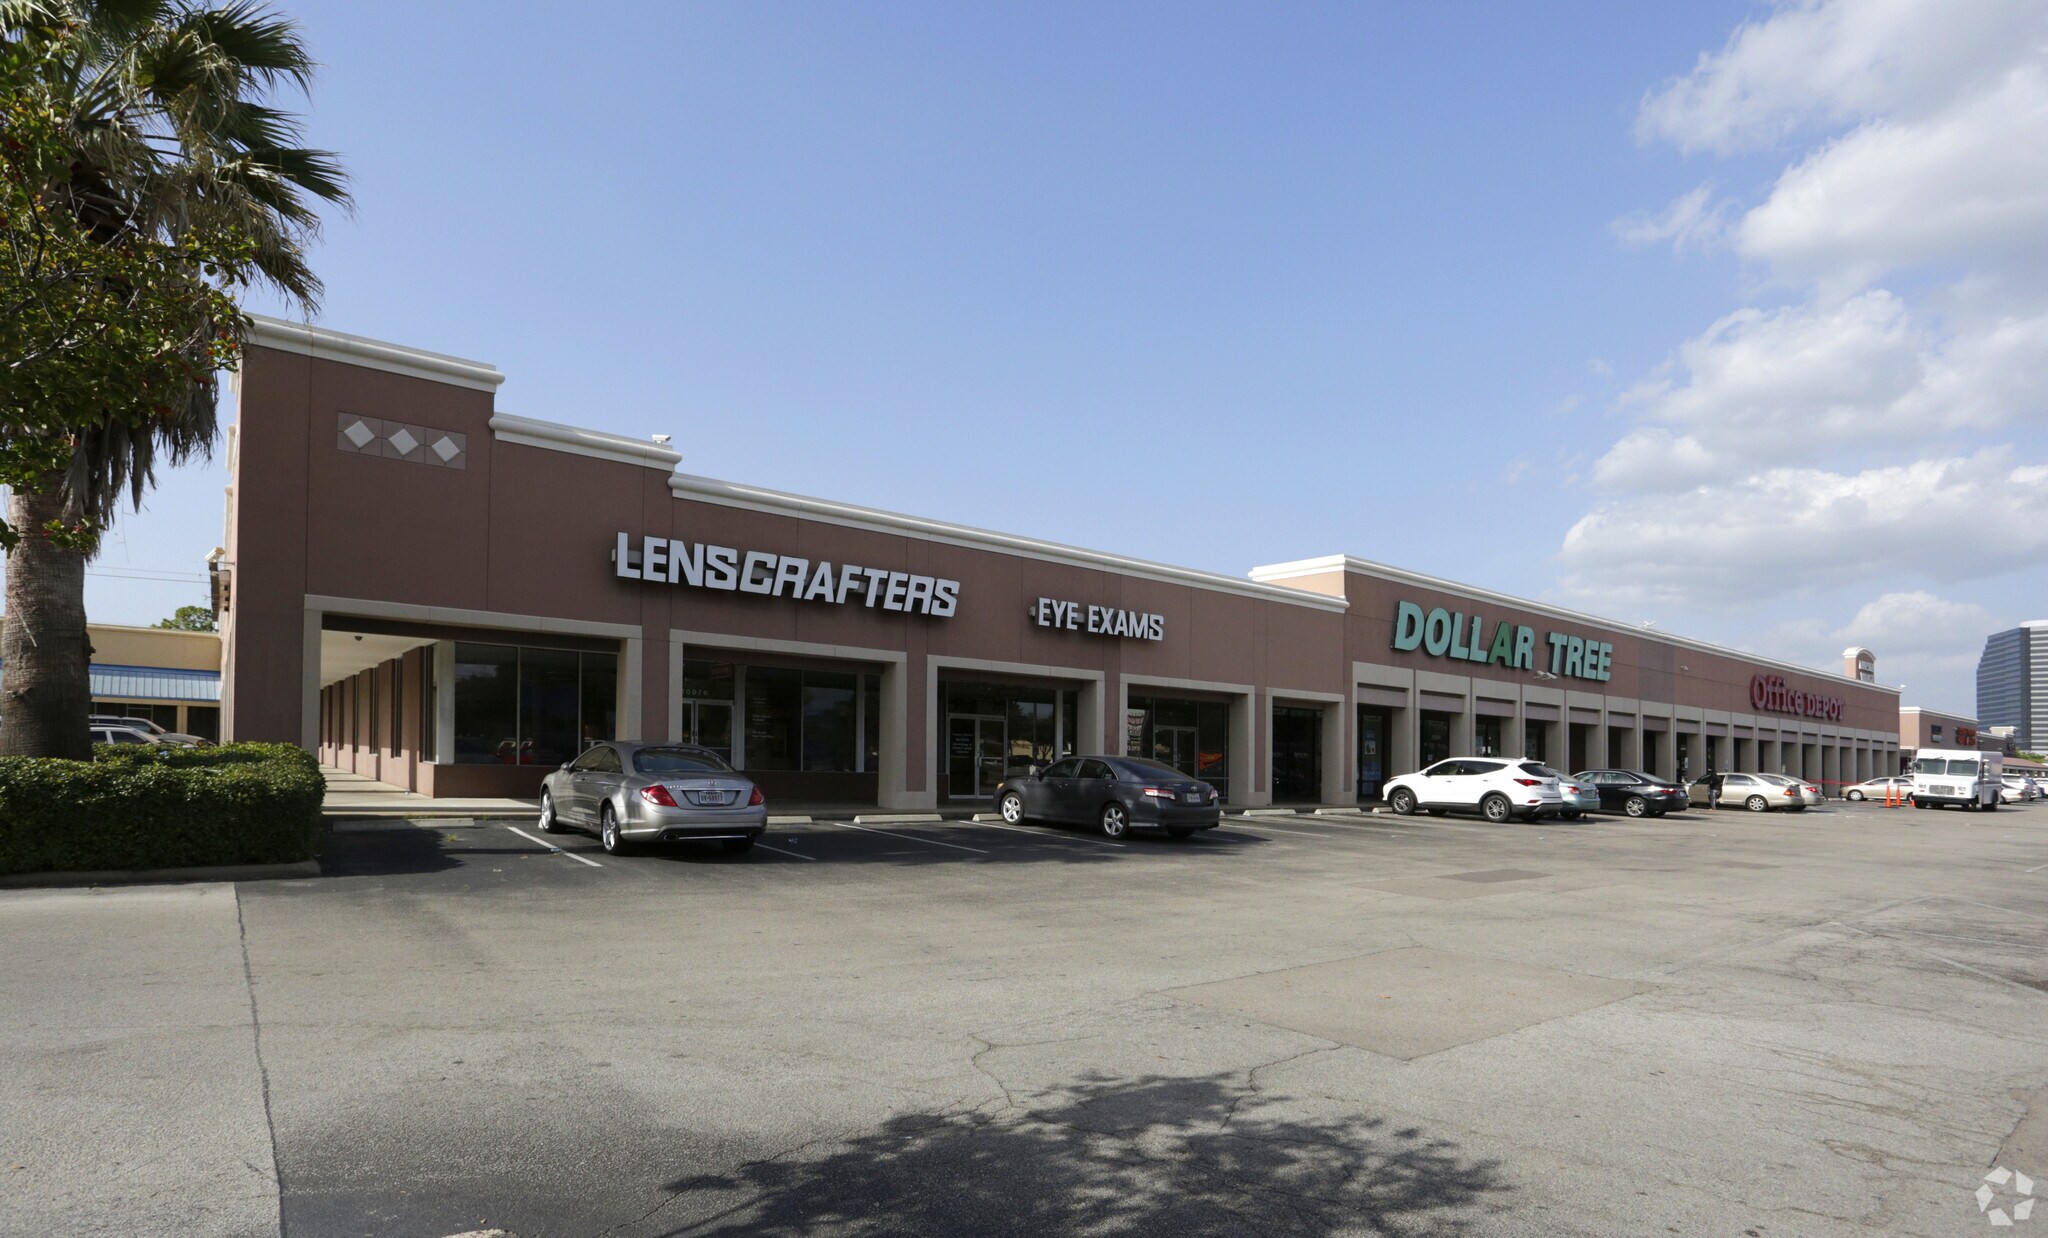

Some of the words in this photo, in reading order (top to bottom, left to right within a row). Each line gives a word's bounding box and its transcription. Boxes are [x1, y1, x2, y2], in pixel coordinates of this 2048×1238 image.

[616, 531, 960, 617] LENSCRAFTERS
[1038, 597, 1080, 631] EYE
[1087, 604, 1164, 641] EXAMS
[1394, 600, 1536, 669] DOLLAR
[1548, 631, 1613, 682] TREE
[1751, 674, 1804, 714] Office
[1806, 694, 1844, 720] DEPOT
